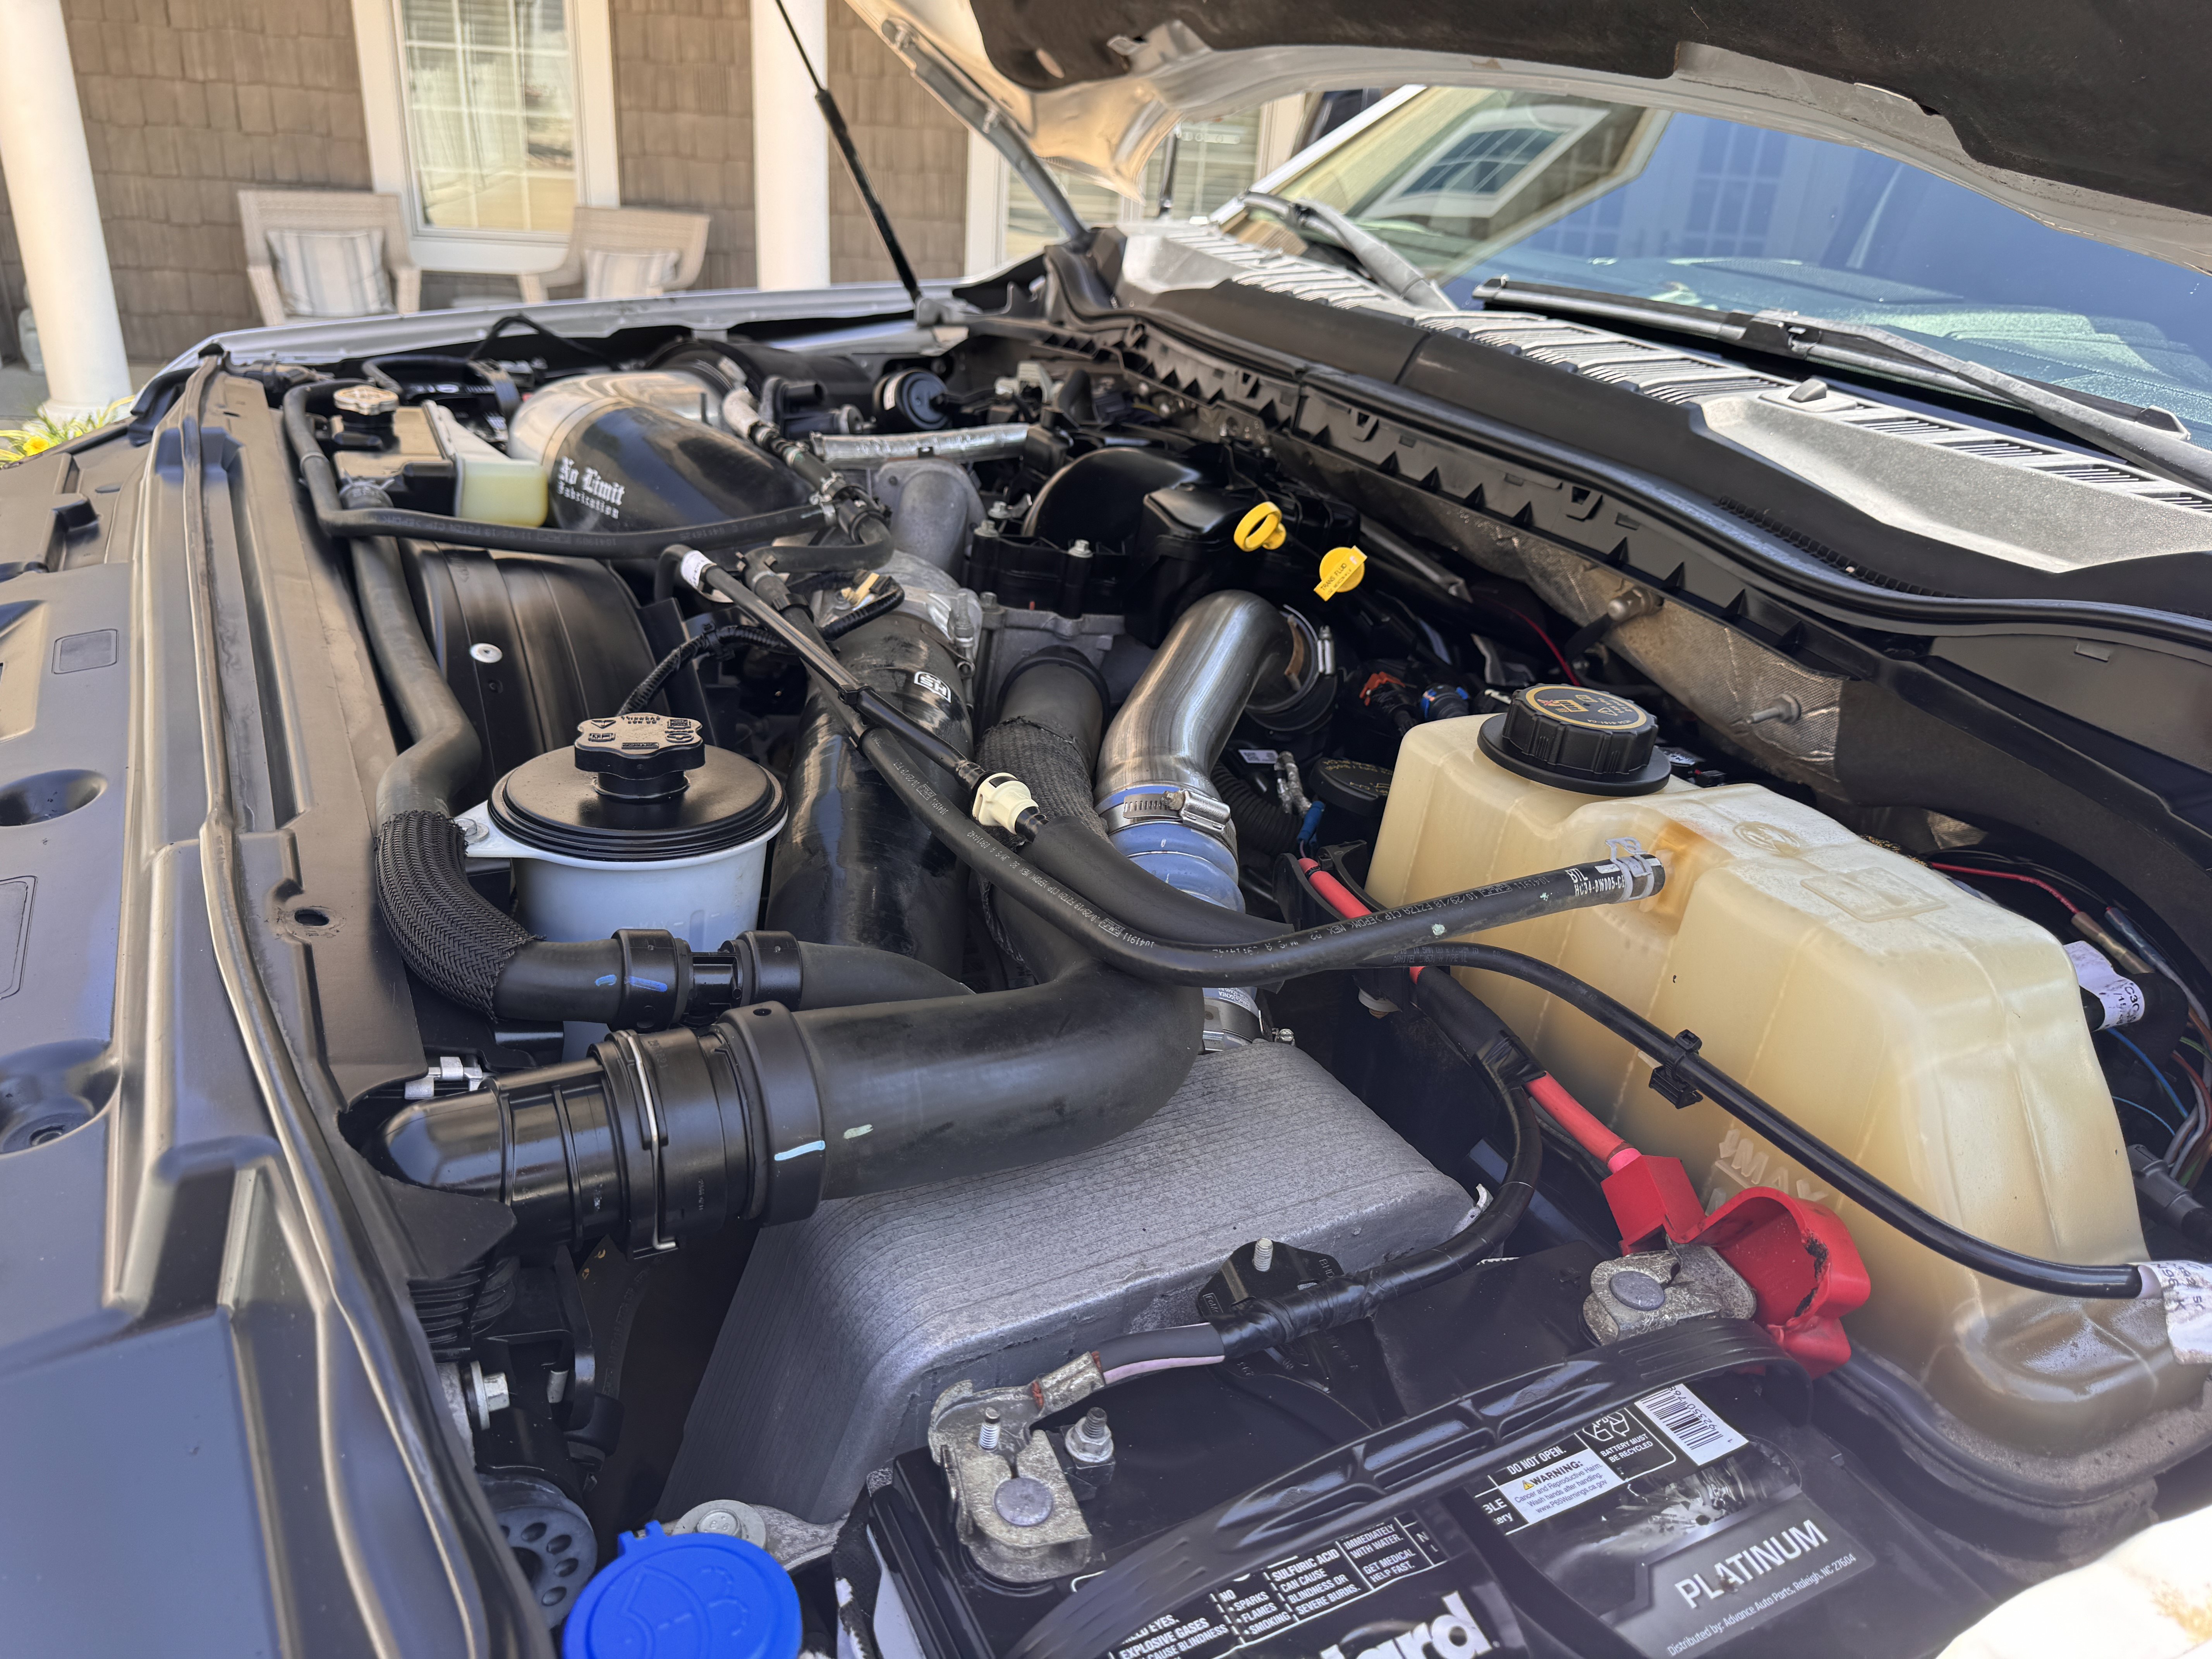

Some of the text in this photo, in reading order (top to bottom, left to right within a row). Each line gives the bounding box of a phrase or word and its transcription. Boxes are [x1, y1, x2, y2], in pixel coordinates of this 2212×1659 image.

[581, 466, 625, 506] Limit
[1320, 573, 1336, 592] TRANS
[1565, 868, 1589, 883] BTL
[1326, 922, 1346, 937] MEX
[1600, 1432, 1649, 1457] BATTERY MUST
[1608, 1440, 1654, 1463] BE RECYCLED
[1506, 1446, 1567, 1475] DO NOT OPEN.
[1530, 1460, 1584, 1486] WARNING:
[1514, 1462, 1603, 1503] Cancer and Reproductive Harm.
[1527, 1473, 1603, 1507] Wash hands after handling.
[1535, 1478, 1608, 1514] www.P65Warnings.ca.gov
[1343, 1524, 1396, 1551] IMMEDIATELY
[1350, 1534, 1404, 1559] WITH WATER.
[1271, 1548, 1341, 1582] SULFURIC ACID
[1362, 1549, 1417, 1575] GET MEDICAL
[1370, 1561, 1415, 1583] HELP FAST.
[1674, 1519, 1829, 1609] PLATINUM
[1279, 1568, 1329, 1593] CAN CAUSE
[1286, 1574, 1350, 1605] BLINDNESS OR
[1218, 1589, 1237, 1602] NO
[1233, 1591, 1270, 1612] SPARKS
[1295, 1583, 1362, 1616] SEVERE BURNS.
[1666, 1553, 1857, 1657] Distributed by: Advance Auto Parts, Raleigh, NC 27604
[1240, 1602, 1278, 1623] FLAMES
[1249, 1611, 1291, 1635] SMOKING
[1119, 1631, 1177, 1659] EXPLOSIVE
[1174, 1618, 1210, 1639] GASES
[1176, 1624, 1230, 1653] BLINDNESS
